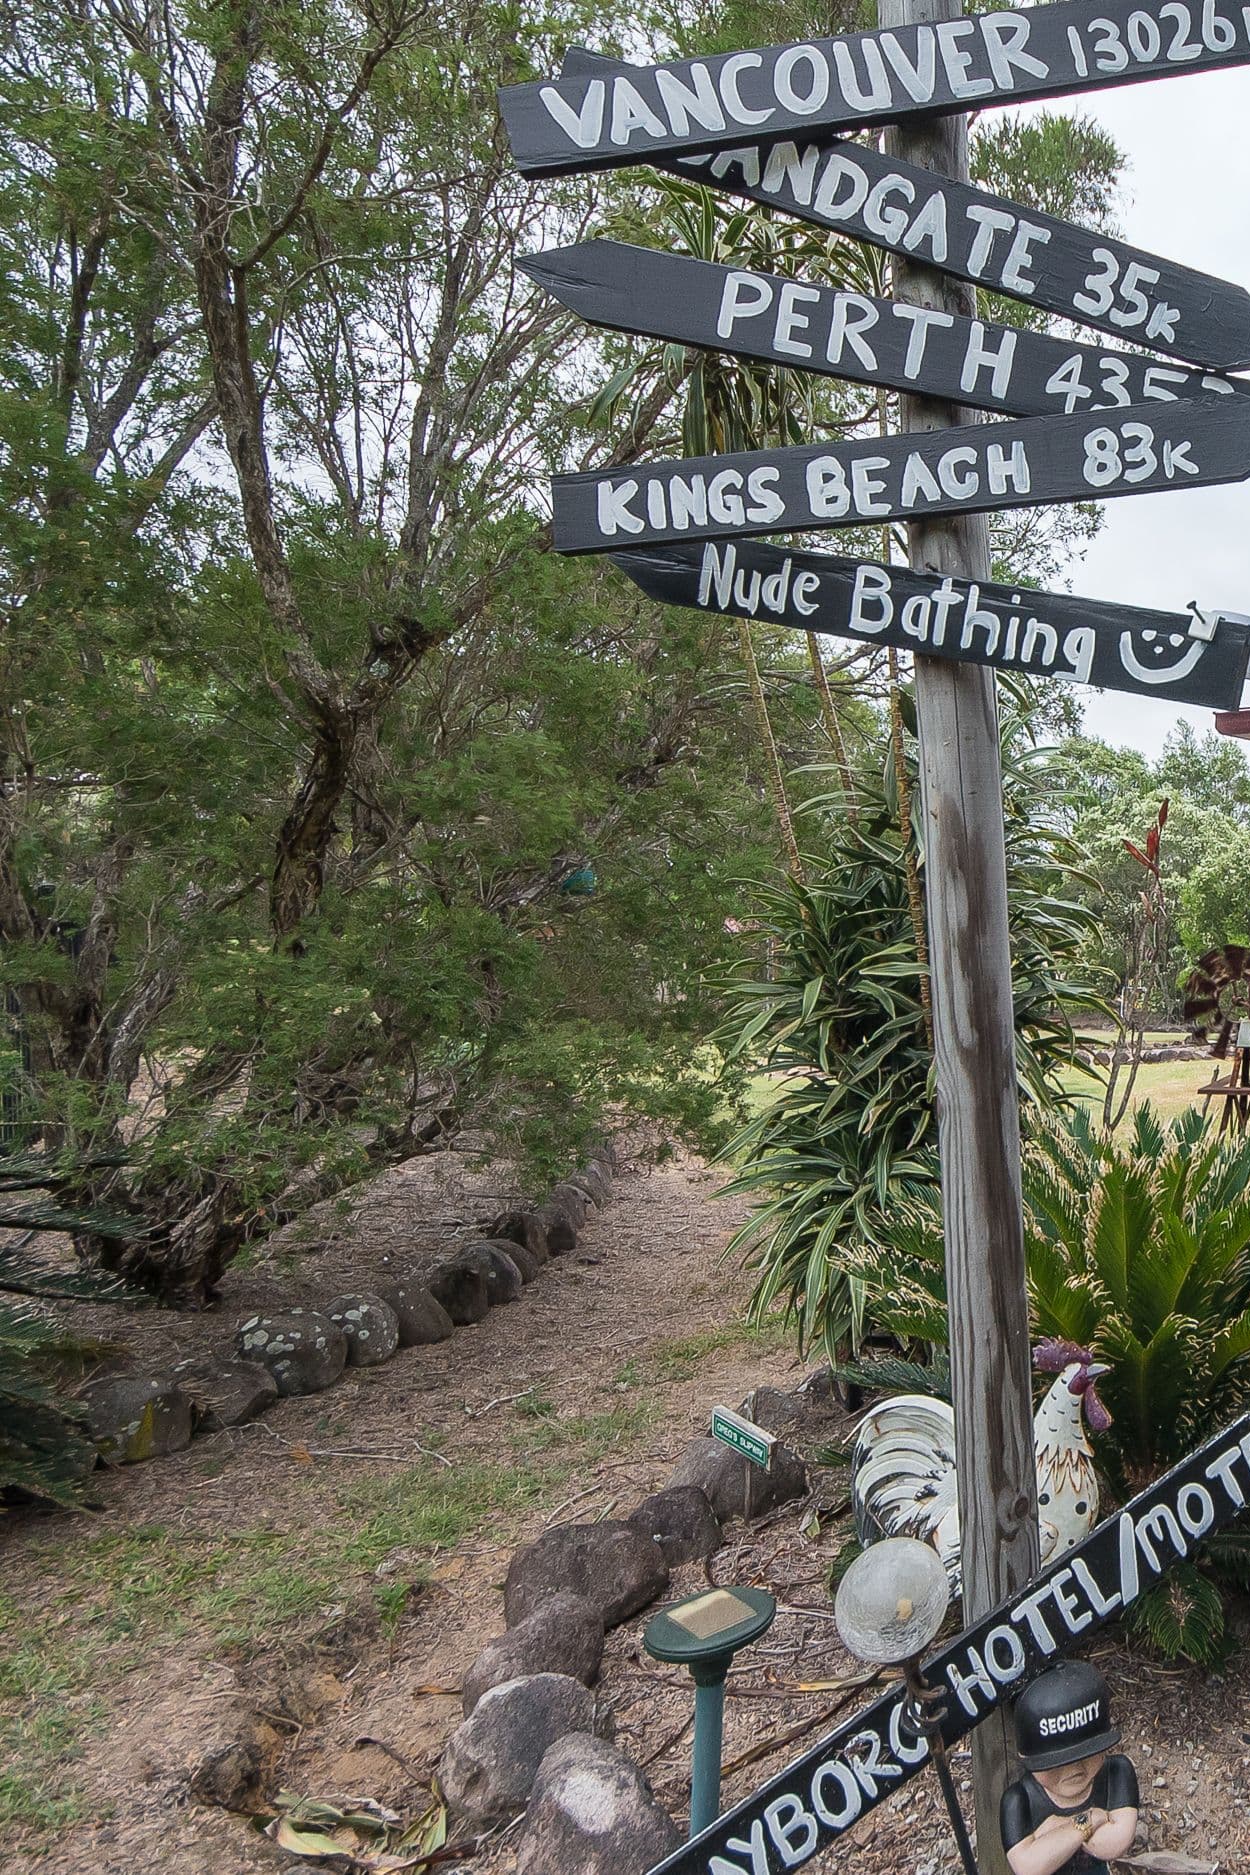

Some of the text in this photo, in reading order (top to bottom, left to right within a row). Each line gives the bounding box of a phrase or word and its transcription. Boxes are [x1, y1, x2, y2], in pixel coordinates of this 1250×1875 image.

[541, 11, 1049, 148] VANCOUVER
[680, 142, 1050, 296] ANDGATE
[716, 271, 1235, 415] PERTH 435
[597, 466, 786, 535] KINGS
[806, 440, 1031, 517] BEACH
[698, 541, 1097, 684] Nude Bathing
[1039, 1699, 1100, 1737] SECURITY
